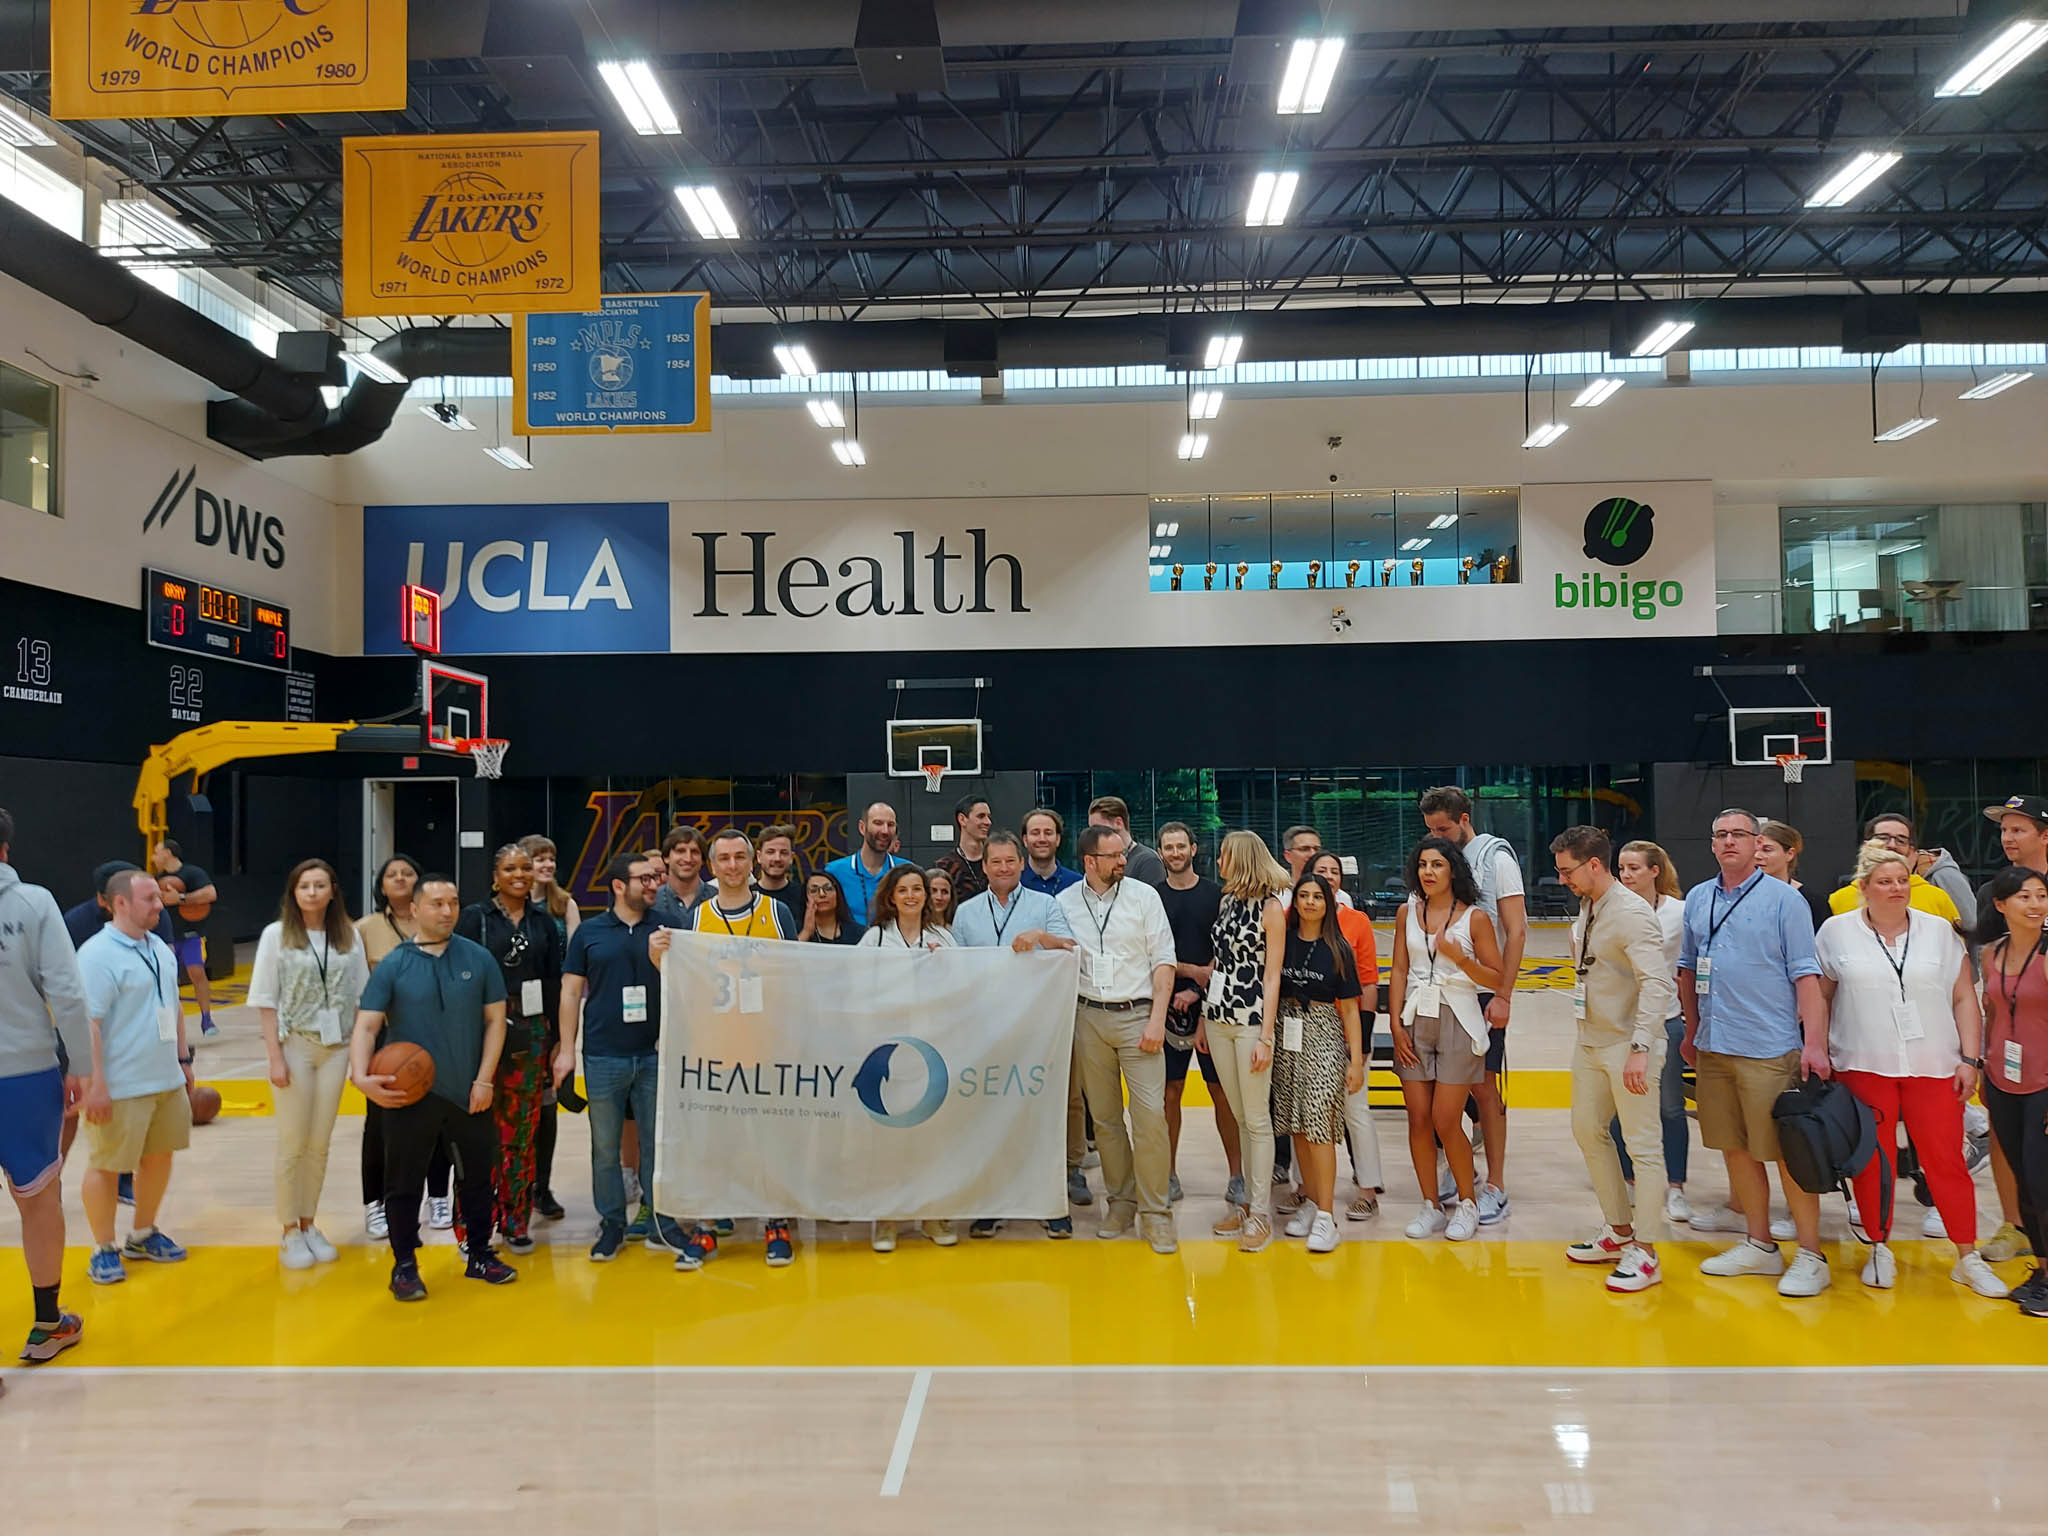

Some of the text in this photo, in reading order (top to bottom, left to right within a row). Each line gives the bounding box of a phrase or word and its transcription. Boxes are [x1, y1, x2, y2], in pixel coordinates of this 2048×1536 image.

[125, 24, 334, 76] WORLD CHAMPIONS
[100, 69, 141, 86] 1979
[315, 63, 356, 79] 1980
[418, 151, 523, 160] NATIONAL BASKETBALL
[441, 161, 501, 169] ASSOCIATION
[447, 192, 545, 202] LOS ANGELES
[407, 195, 547, 243] LAKERS
[397, 250, 548, 287] WORLD CHAMPIONS
[379, 281, 408, 293] 1971
[535, 278, 565, 289] 1972
[605, 300, 660, 308] BASKETBALL
[531, 336, 557, 346] 1949
[578, 320, 642, 352] MPLS
[665, 333, 690, 343] 1953
[531, 362, 557, 372] 1950
[665, 360, 690, 369] 1954
[532, 391, 557, 401] 1952
[556, 410, 667, 422] WORLD CHAMPIONS
[195, 487, 285, 570] DWS
[405, 529, 1031, 618] UCLA Health
[1555, 572, 1683, 620] bibigo
[172, 604, 185, 636] 0
[235, 636, 240, 655] 1
[275, 630, 286, 658] 0
[17, 637, 51, 685] 13
[3, 685, 63, 704] CHAMBERLAIN
[170, 664, 203, 708] 22
[171, 708, 201, 722] BAYLOR
[680, 1055, 1045, 1098] HEALTHY SEAS
[687, 1101, 728, 1115] journey
[731, 1105, 758, 1117] from
[762, 1107, 795, 1117] waste
[800, 1107, 810, 1117] to
[814, 1109, 841, 1119] wear
